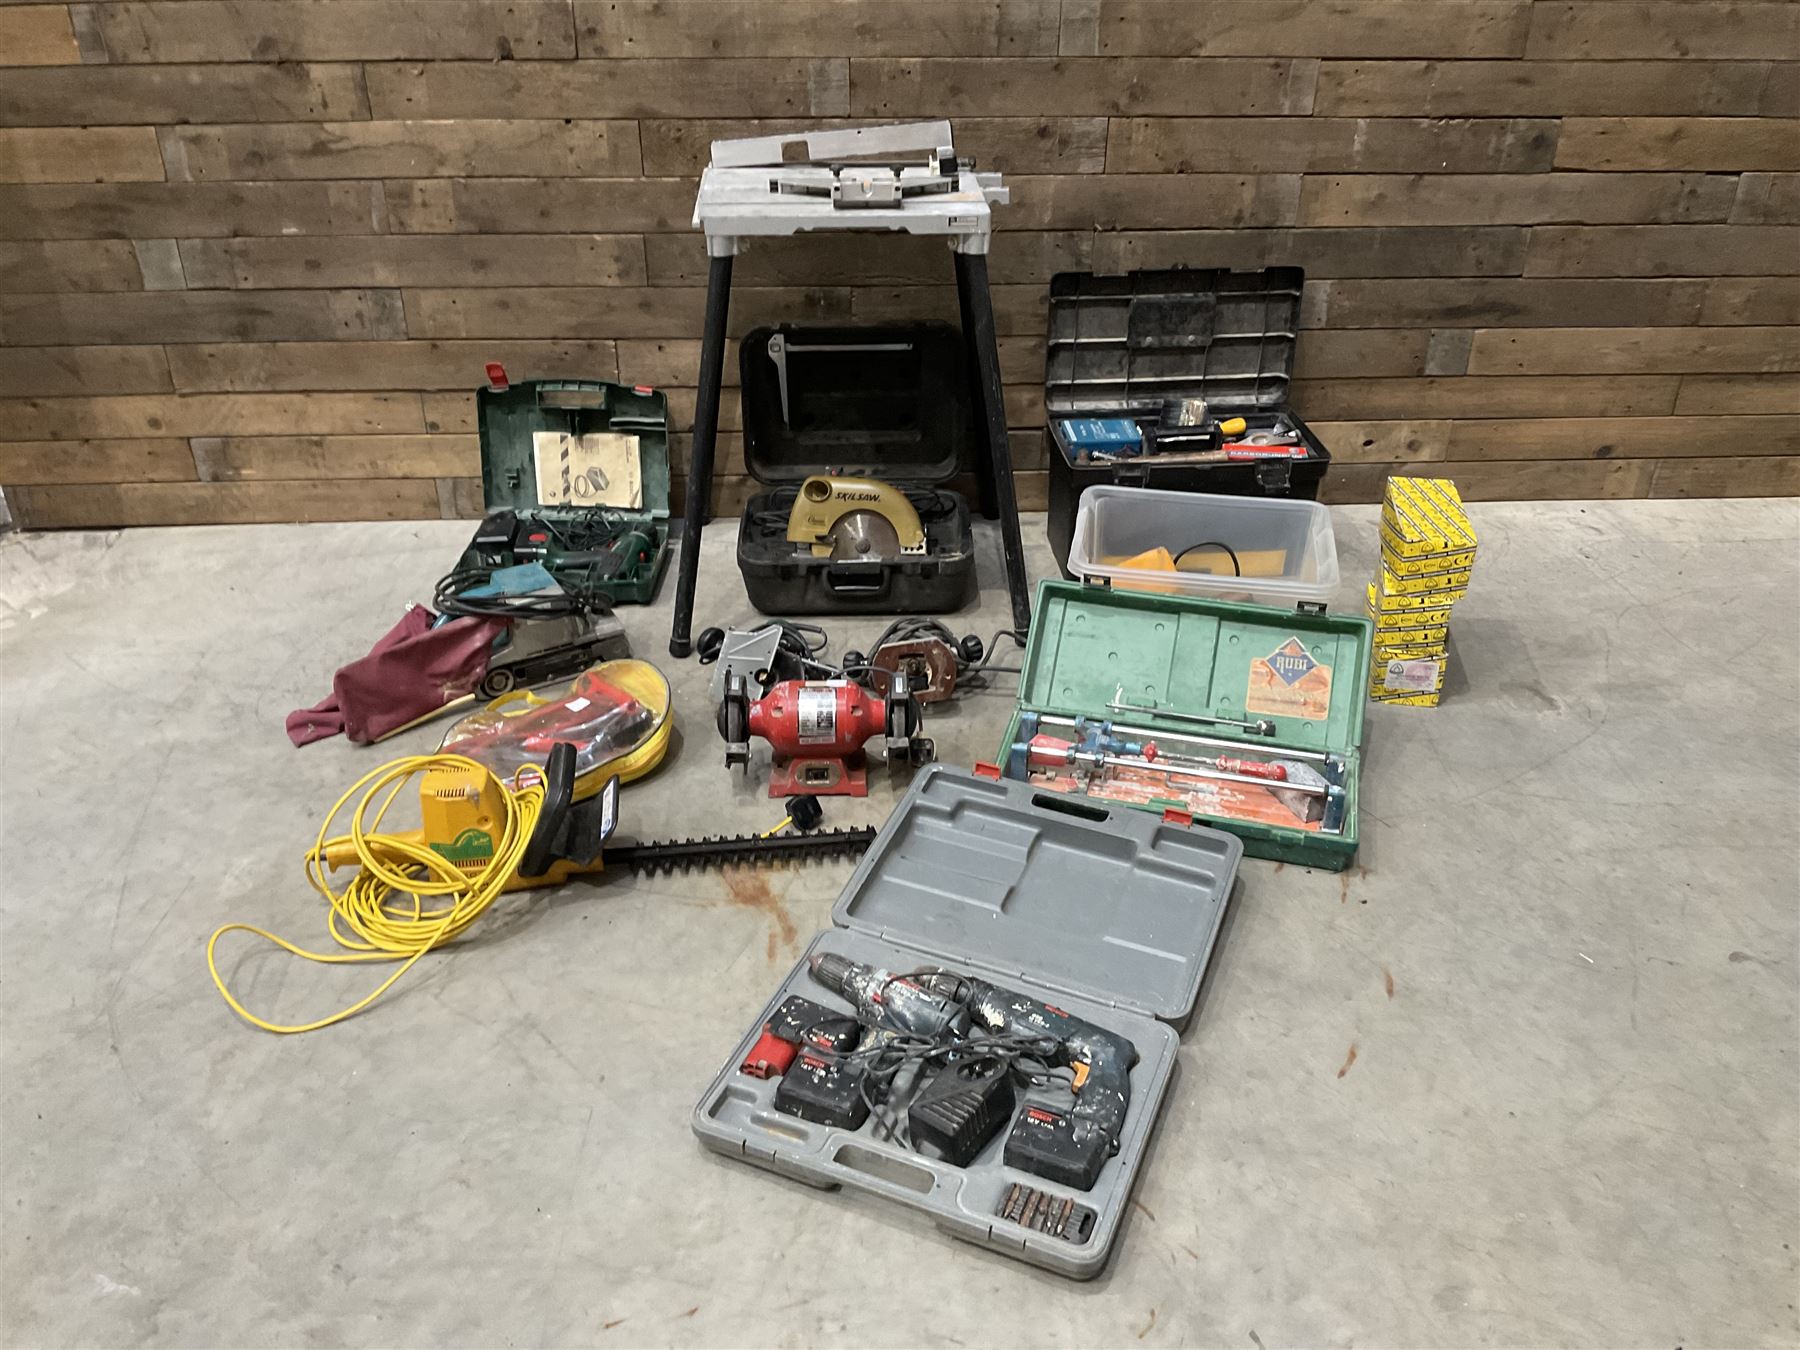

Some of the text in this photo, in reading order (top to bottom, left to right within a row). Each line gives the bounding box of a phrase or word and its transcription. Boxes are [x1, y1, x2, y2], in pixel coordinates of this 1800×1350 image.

[835, 492, 880, 503] SKILSAW
[1276, 656, 1308, 673] RUBI
[1029, 1110, 1052, 1122] BOSCH
